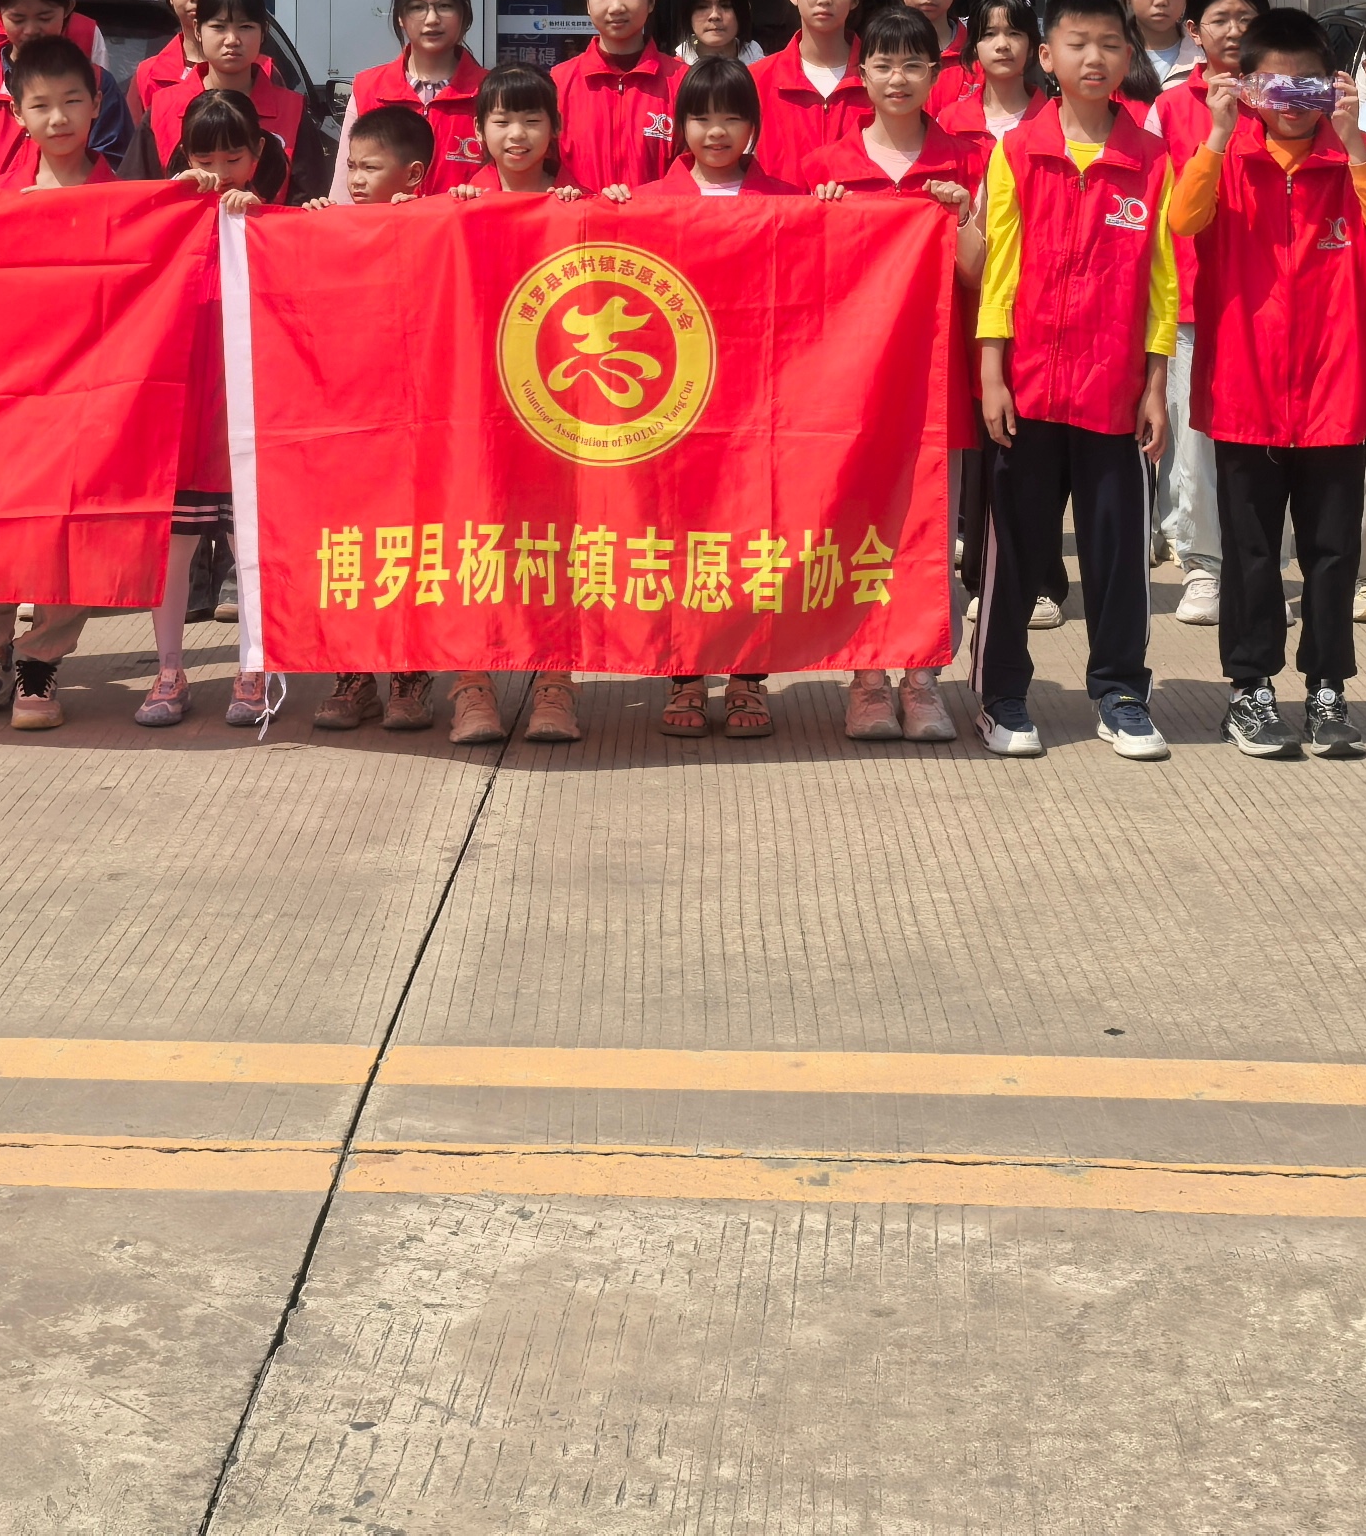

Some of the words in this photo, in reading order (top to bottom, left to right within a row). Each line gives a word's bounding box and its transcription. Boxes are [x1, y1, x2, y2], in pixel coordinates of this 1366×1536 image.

[518, 254, 695, 331] 博罗县杨村镇志愿者协会
[317, 520, 895, 614] 博罗县杨村镇志愿者协会
